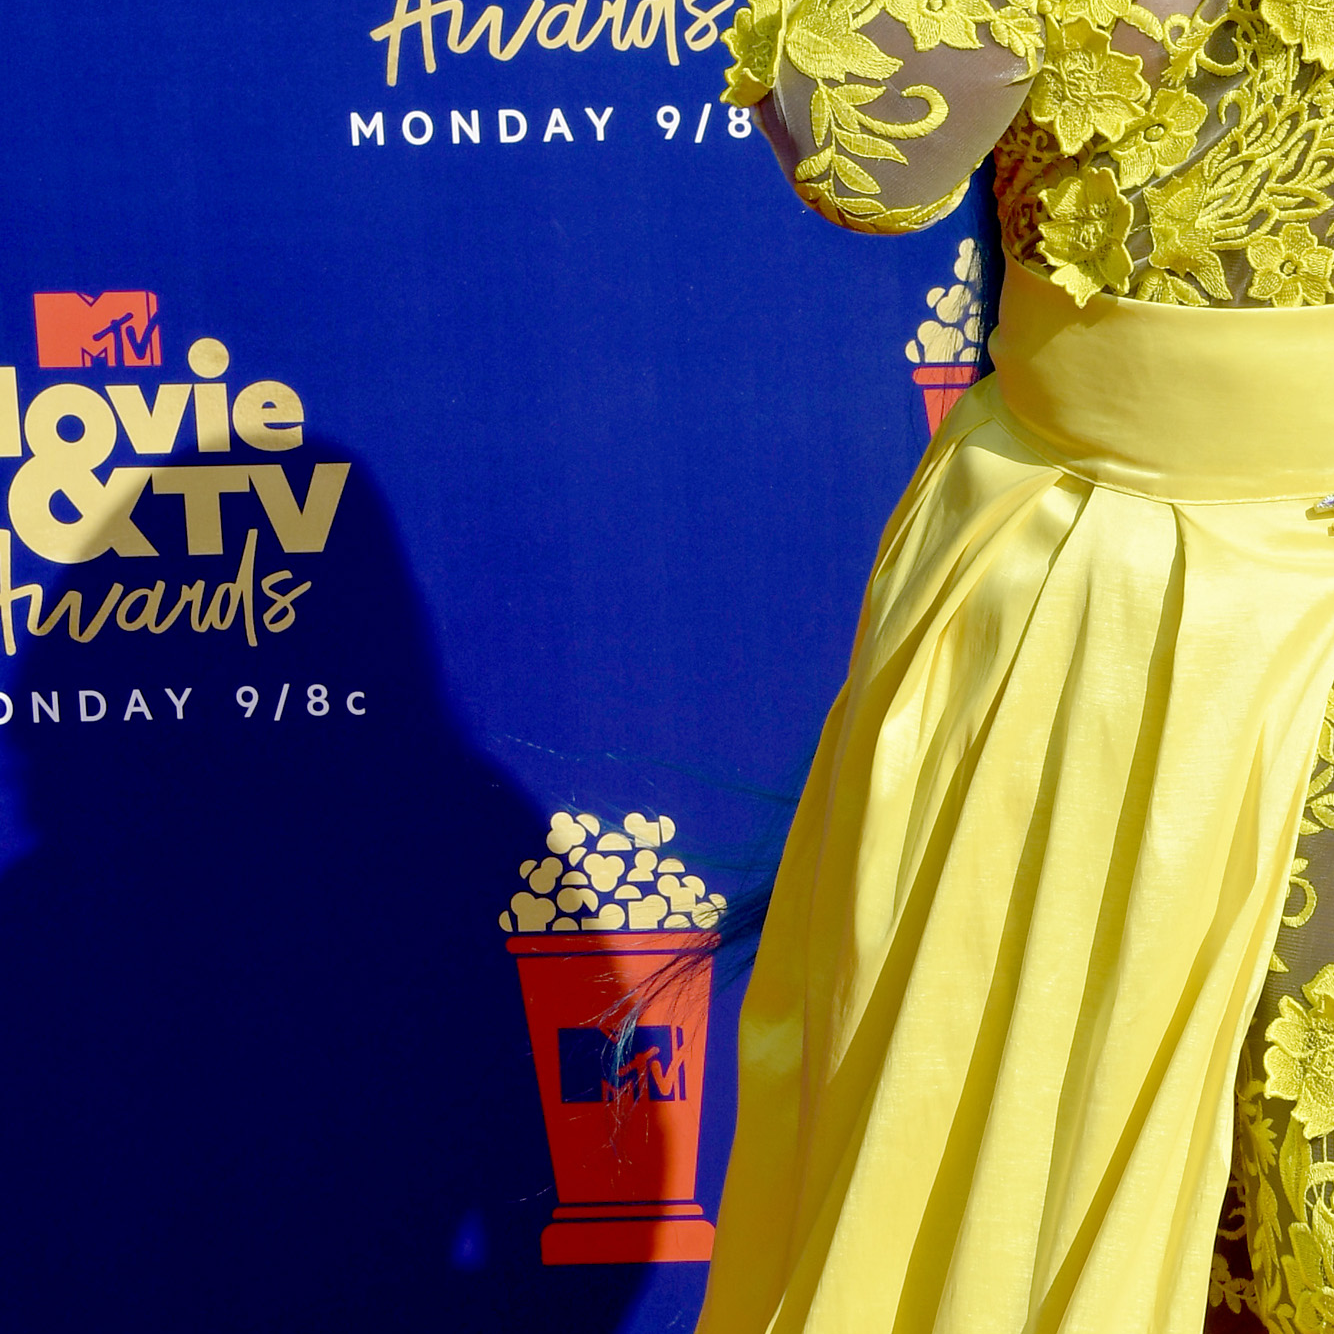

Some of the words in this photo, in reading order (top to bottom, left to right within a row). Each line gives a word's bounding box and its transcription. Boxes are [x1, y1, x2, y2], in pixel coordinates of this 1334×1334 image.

[350, 107, 614, 146] MONDAY
[656, 103, 752, 144] 9/8
[33, 291, 163, 368] MTV
[0, 338, 304, 456] ovie
[236, 683, 367, 721] 9/8c
[557, 1025, 687, 1103] MTV
